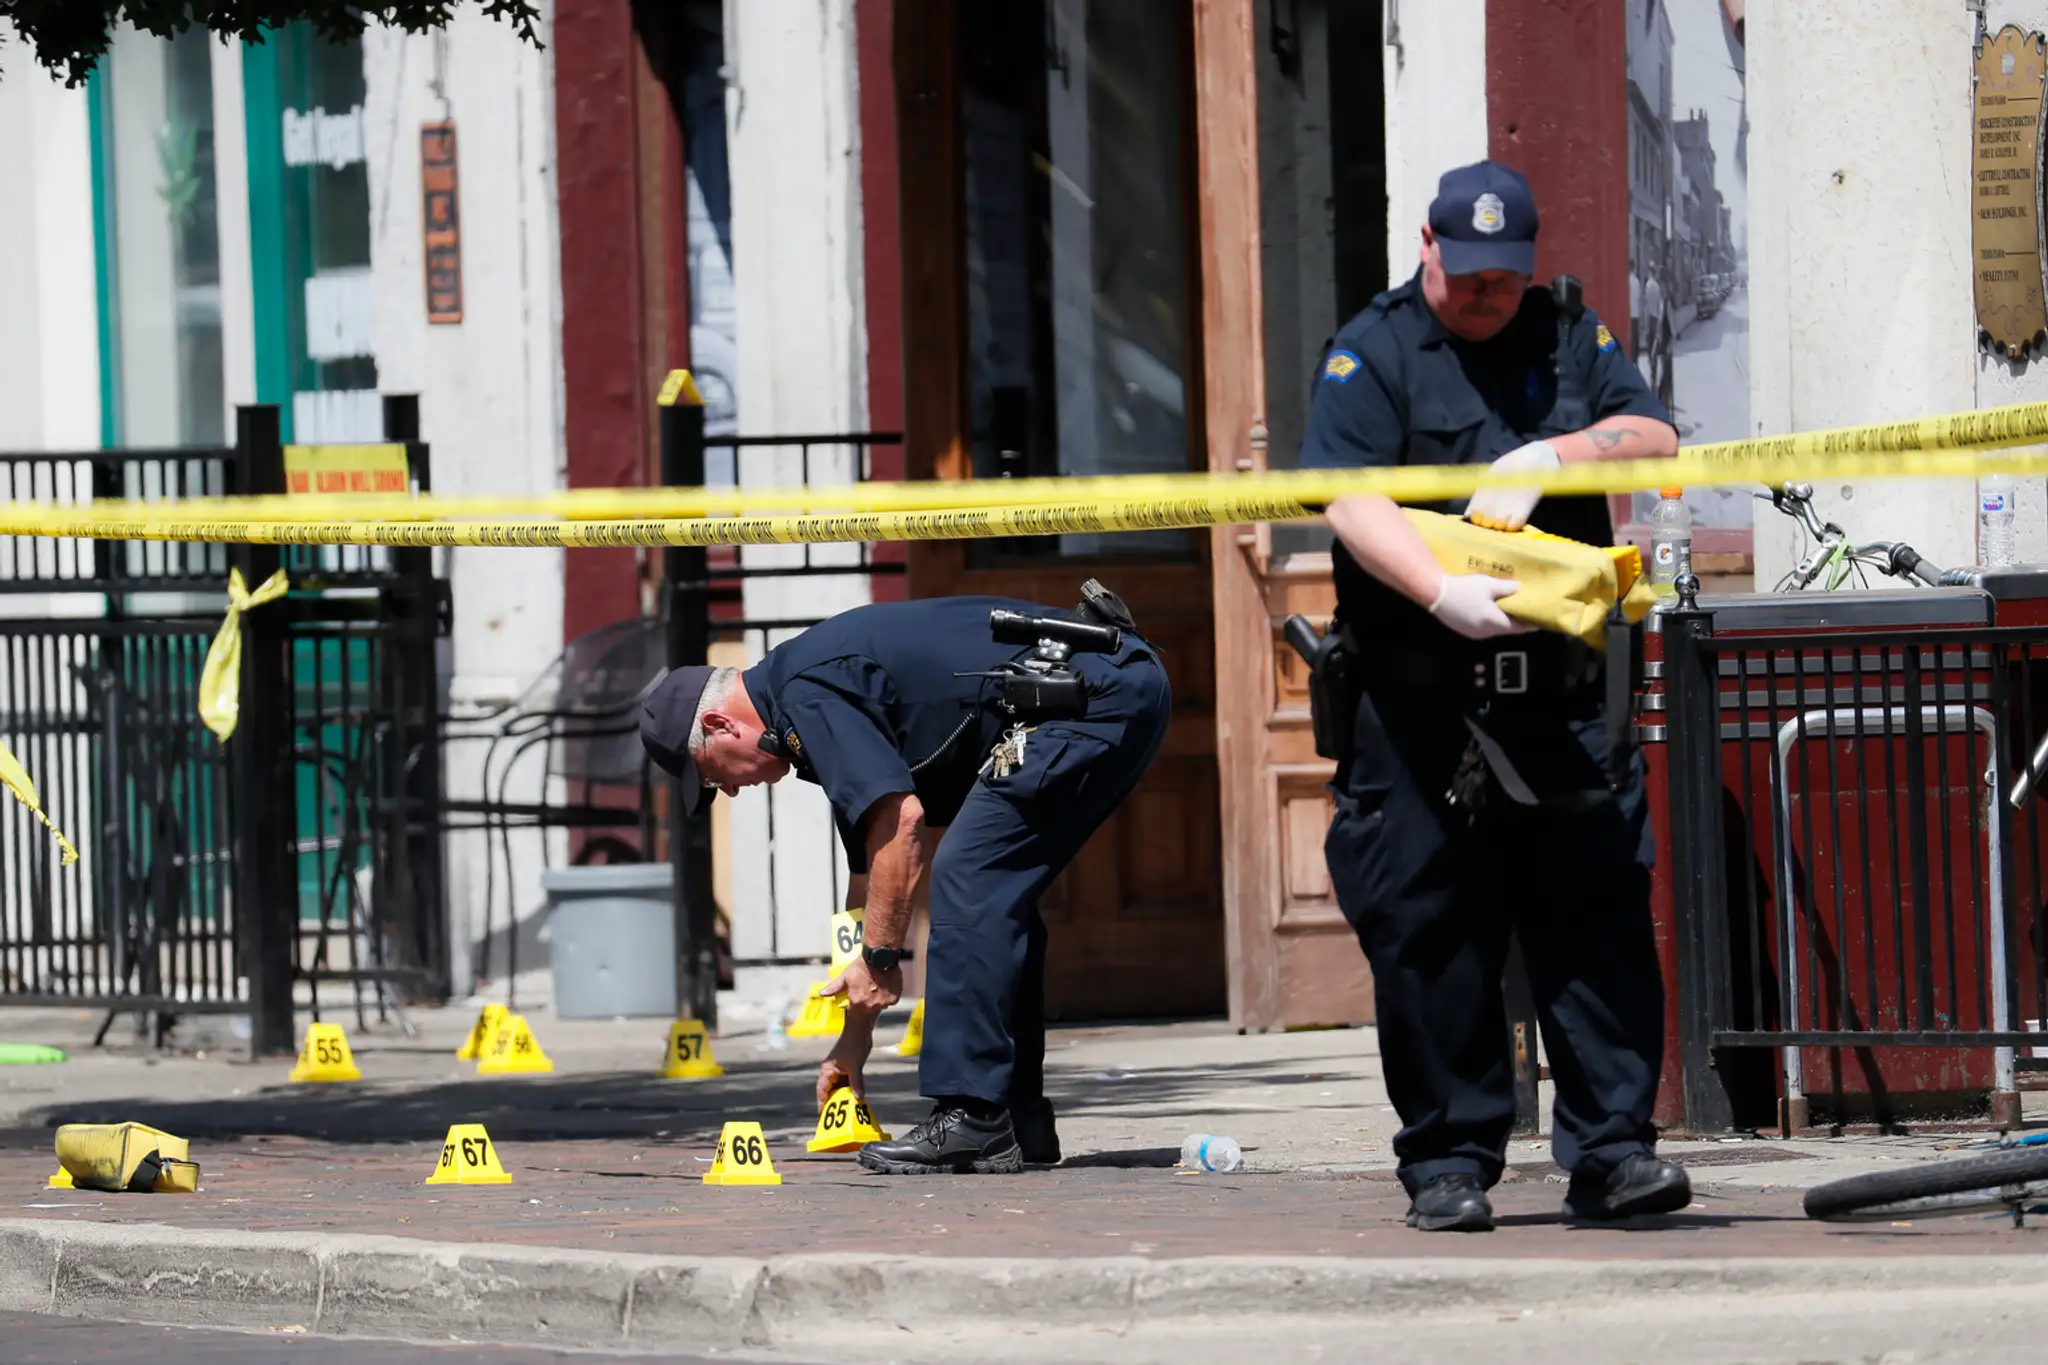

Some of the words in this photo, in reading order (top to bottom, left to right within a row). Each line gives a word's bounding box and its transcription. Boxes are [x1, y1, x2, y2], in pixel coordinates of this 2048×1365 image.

[837, 919, 863, 953] 64
[316, 1038, 343, 1064] 55
[677, 1033, 703, 1061] 57
[823, 1099, 849, 1130] 65
[855, 1104, 871, 1125] 65
[442, 1144, 455, 1168] 67
[462, 1137, 487, 1167] 67
[732, 1135, 762, 1165] 66
